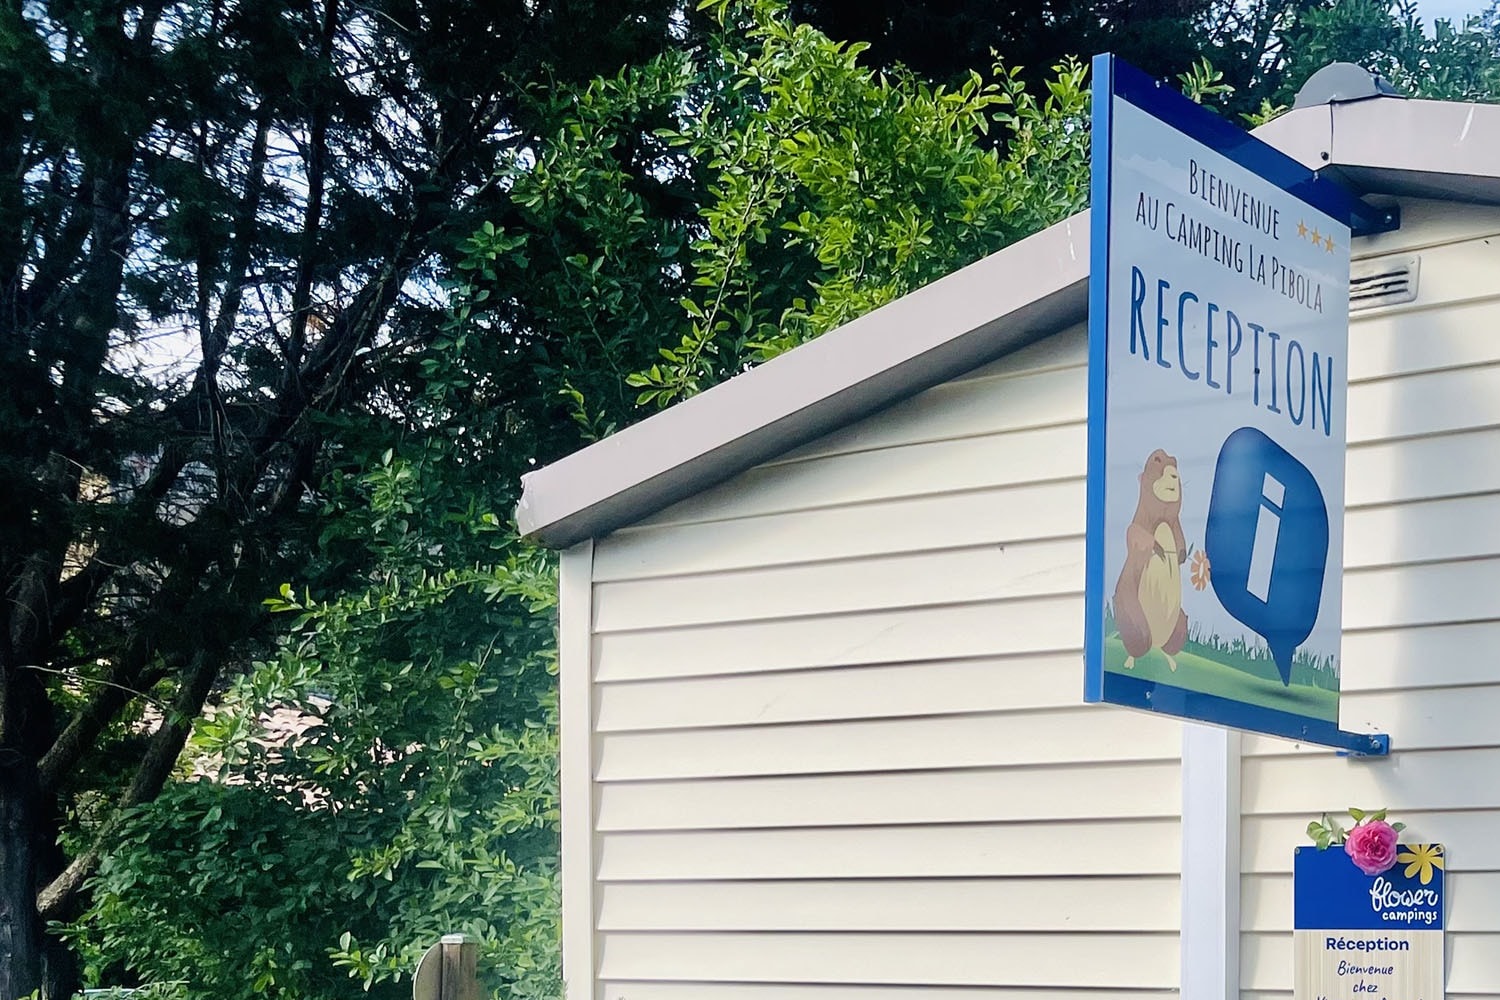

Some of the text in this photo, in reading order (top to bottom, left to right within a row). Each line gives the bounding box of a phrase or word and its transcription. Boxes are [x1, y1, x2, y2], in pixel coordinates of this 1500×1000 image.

[1189, 158, 1280, 241] BIENVENUE
[1135, 191, 1323, 314] AU CAMPING LA PIBOLA
[1130, 265, 1333, 437] RECEPTION
[1369, 876, 1439, 912] flower
[1382, 909, 1438, 924] campings
[1326, 937, 1410, 953] Réception
[1337, 960, 1394, 976] Bienvenue
[1352, 979, 1379, 994] chez
